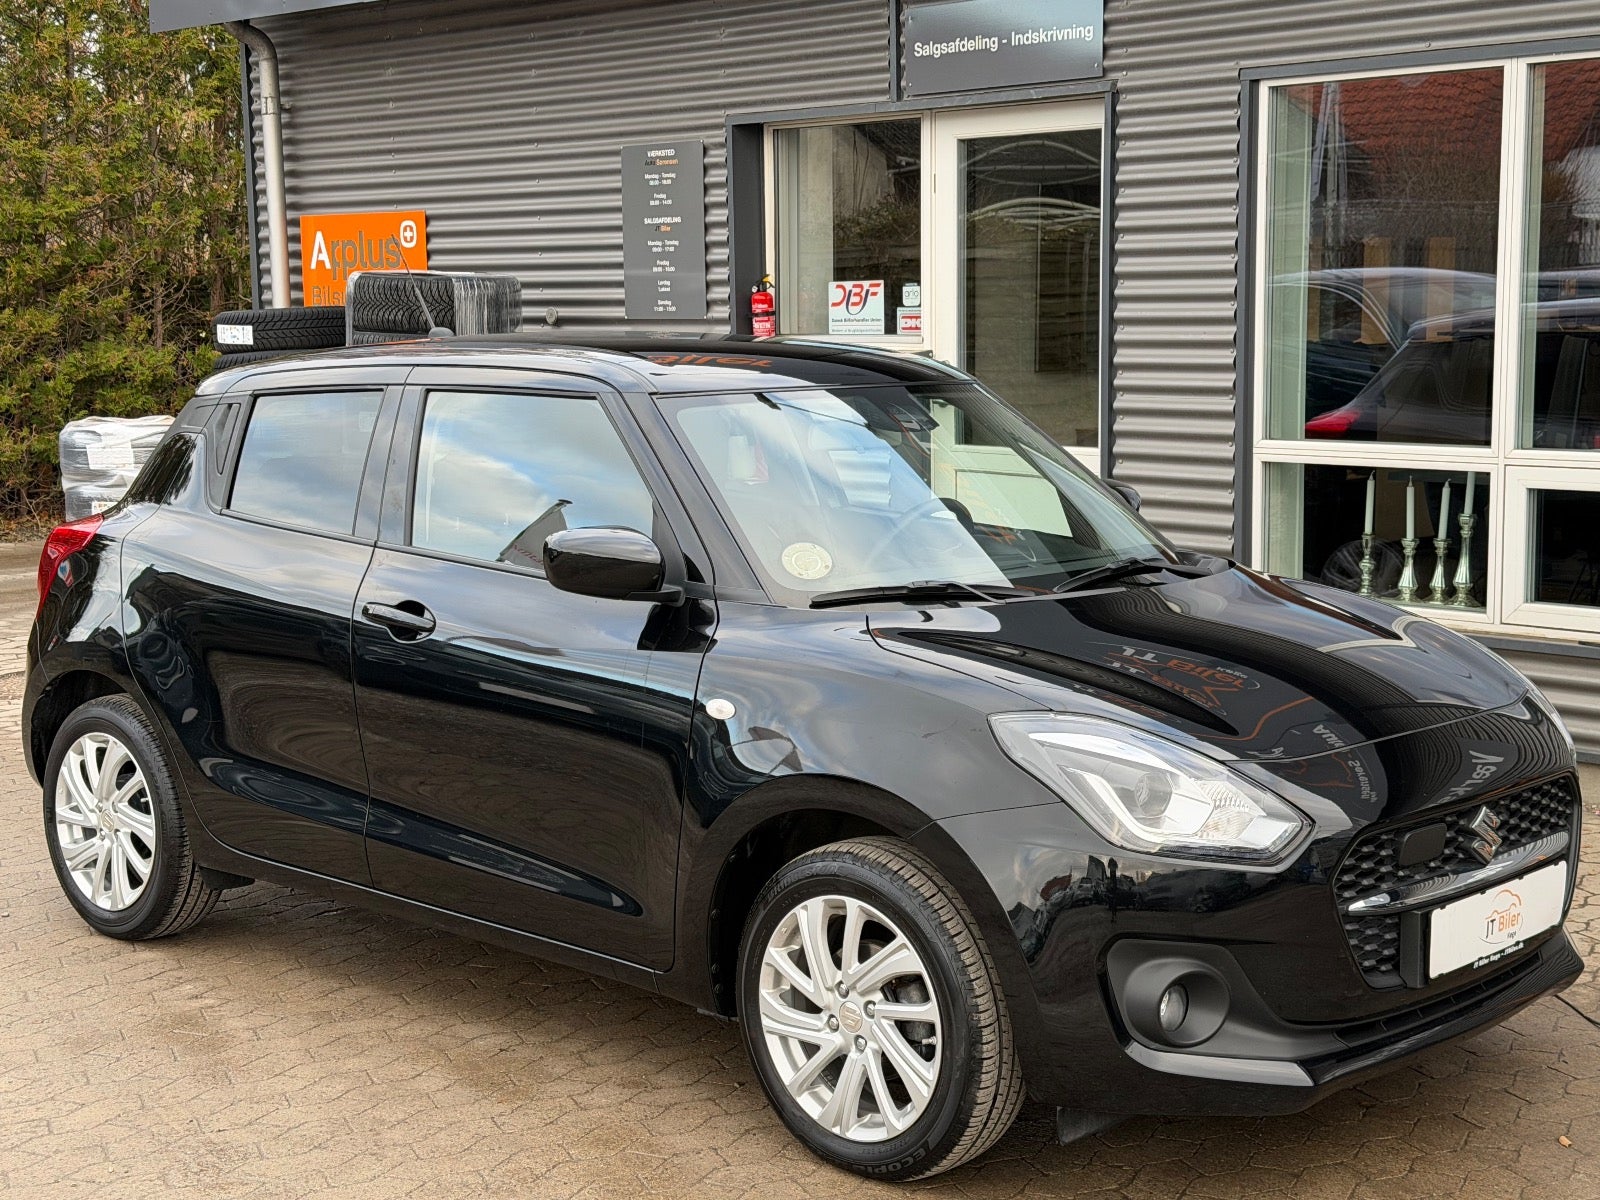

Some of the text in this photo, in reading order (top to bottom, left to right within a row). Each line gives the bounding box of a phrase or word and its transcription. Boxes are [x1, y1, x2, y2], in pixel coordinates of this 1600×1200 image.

[914, 35, 999, 58] Salgsafdeling
[1011, 25, 1094, 46] Indskrivning
[1498, 911, 1521, 932] Biler
